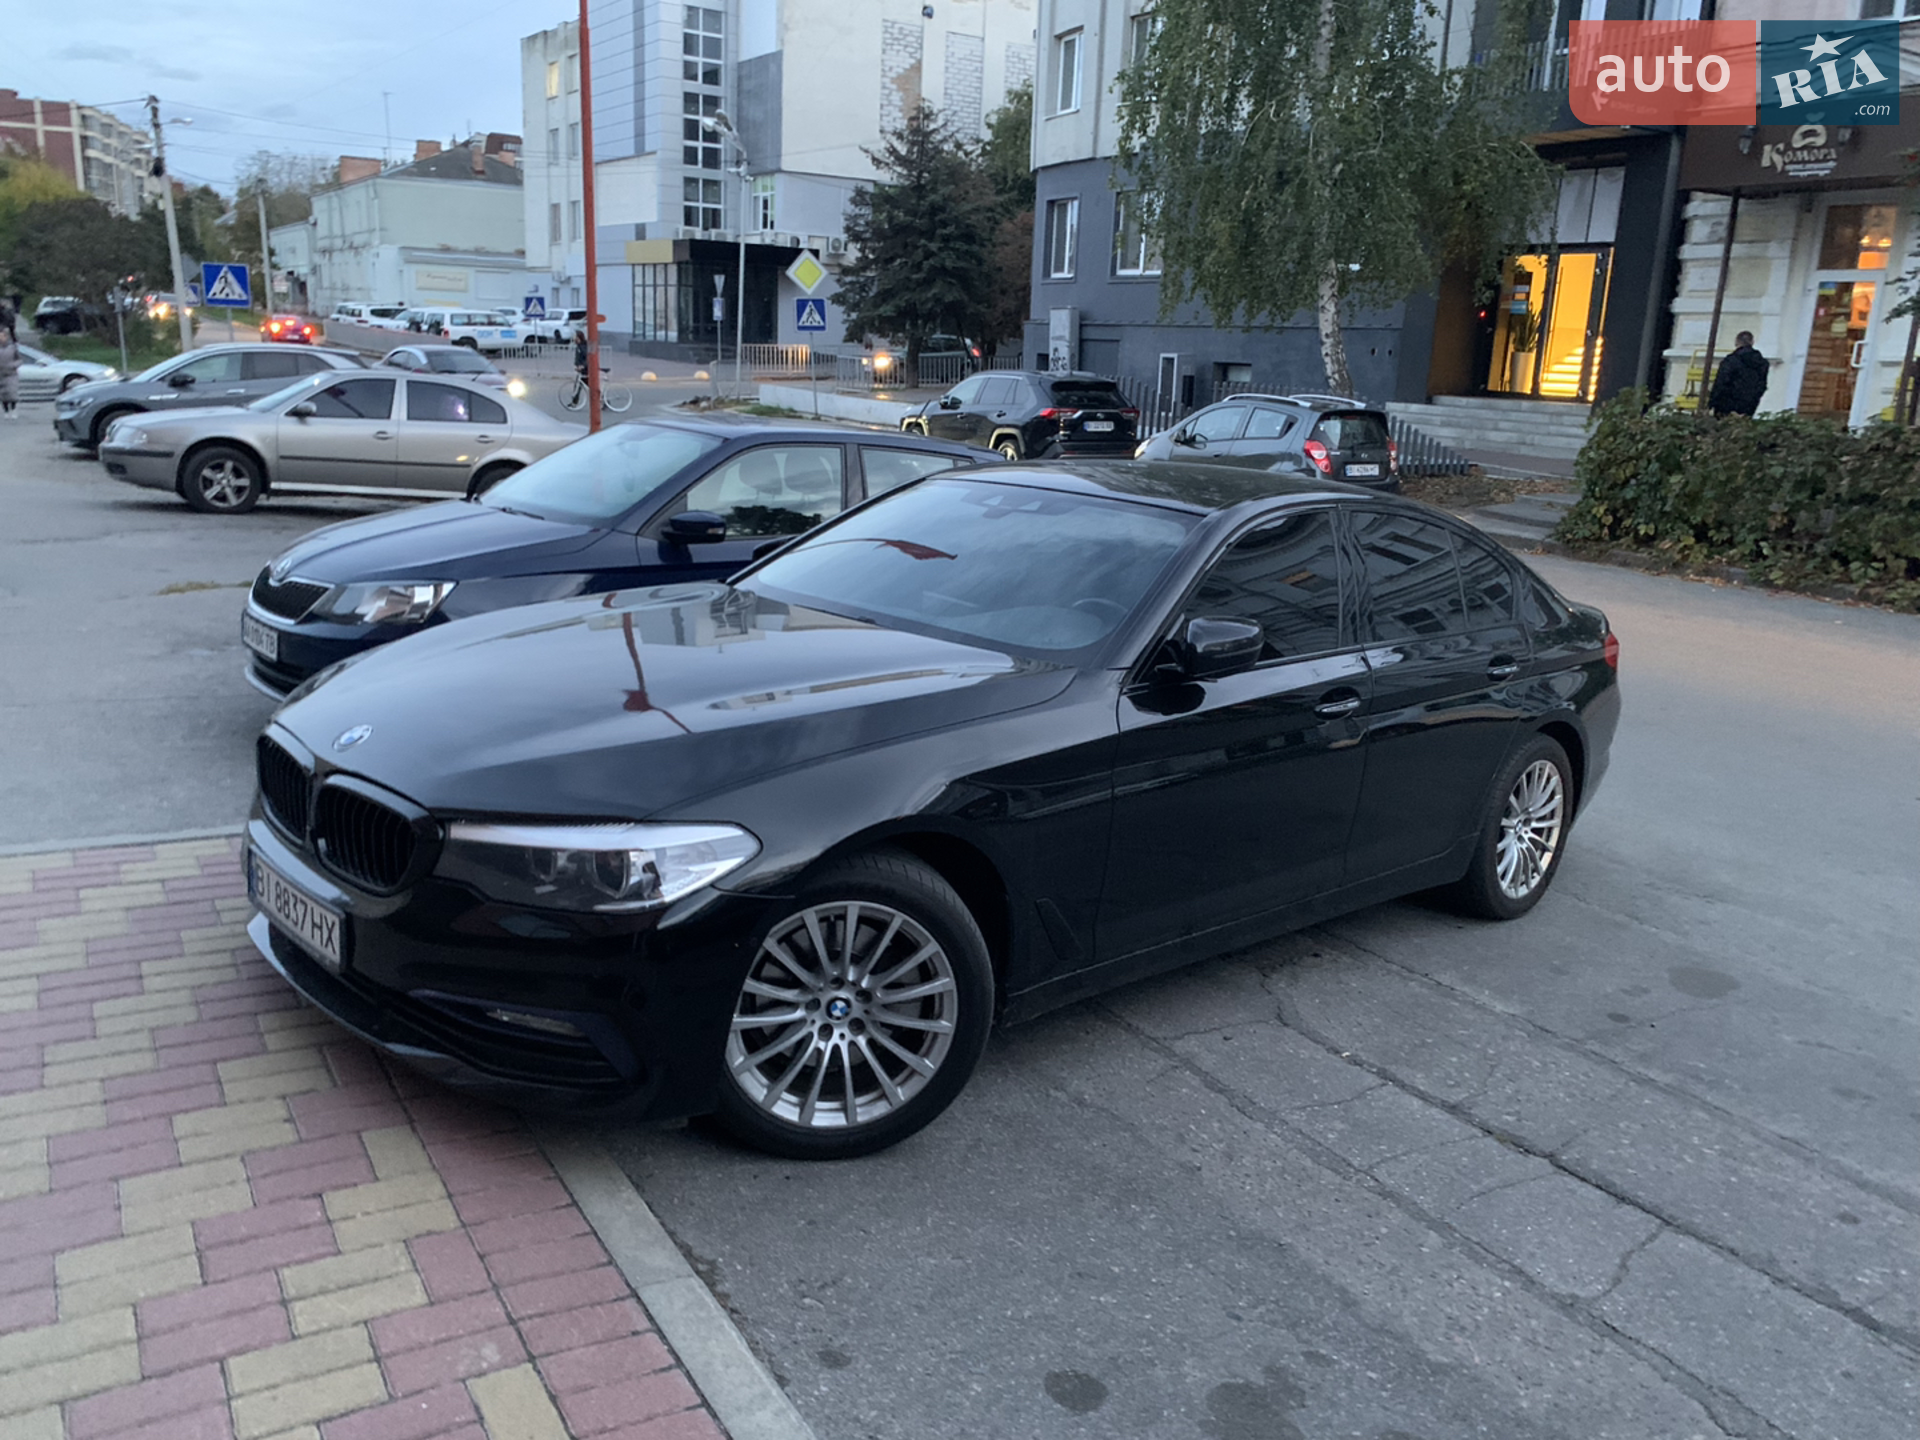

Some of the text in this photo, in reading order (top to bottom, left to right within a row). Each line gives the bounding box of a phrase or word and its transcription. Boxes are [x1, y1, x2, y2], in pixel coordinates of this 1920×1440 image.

[256, 863, 337, 955] BI 8837 HX
